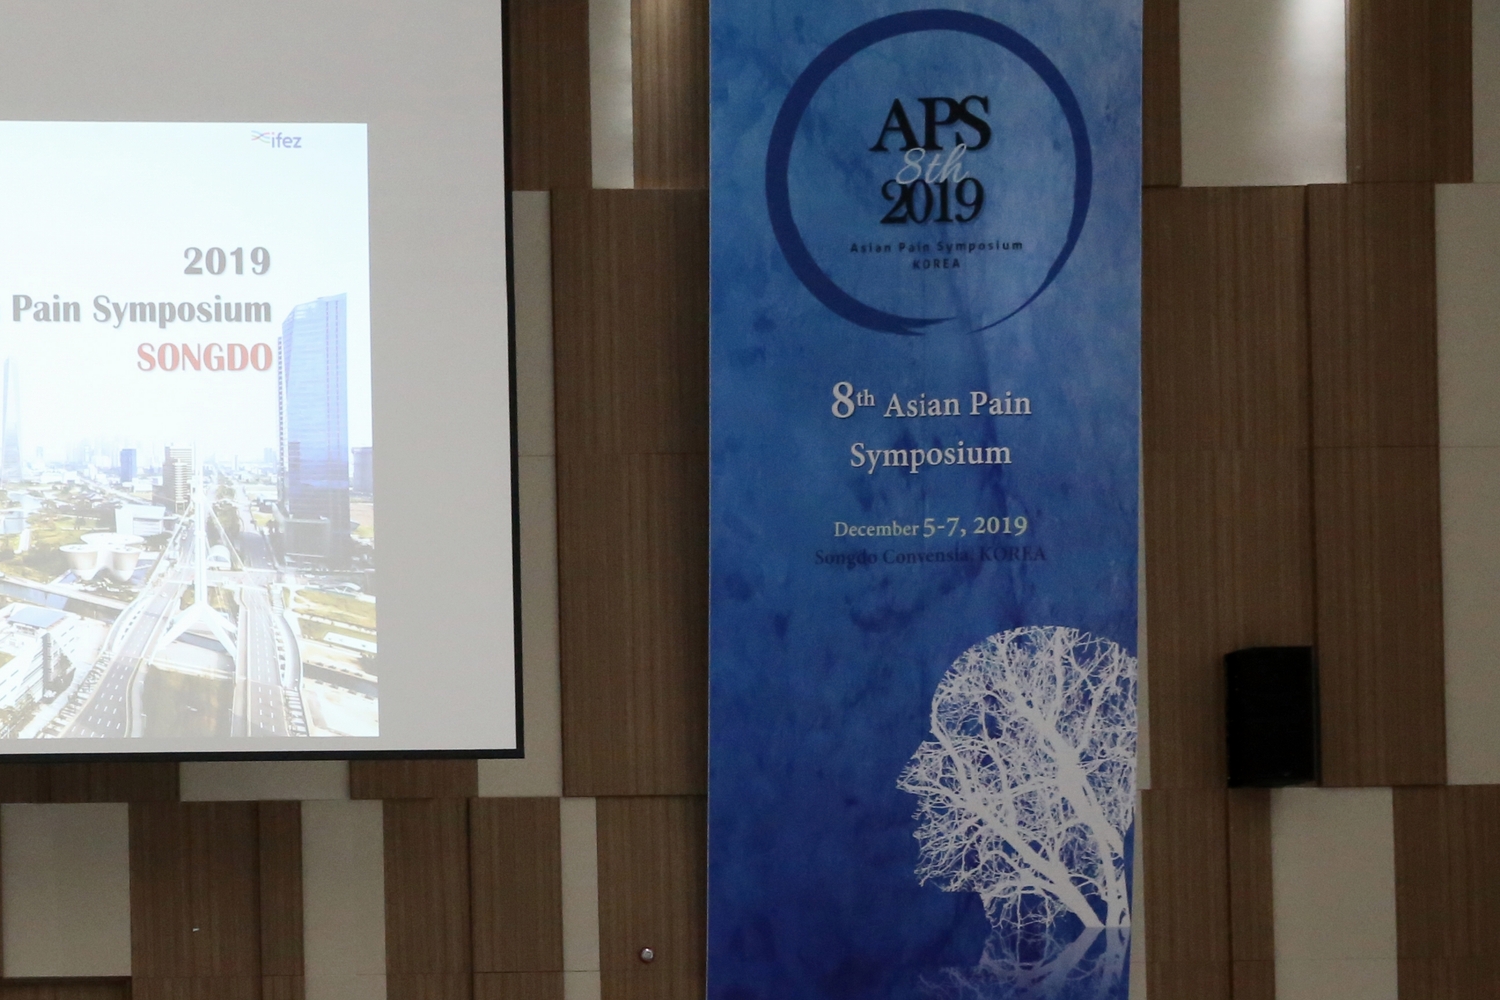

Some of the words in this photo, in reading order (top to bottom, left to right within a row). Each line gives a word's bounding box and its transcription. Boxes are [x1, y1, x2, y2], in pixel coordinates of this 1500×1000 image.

[868, 95, 992, 152] APS
[271, 132, 302, 148] ifez
[895, 144, 971, 185] 8th
[880, 178, 985, 225] 2019
[182, 246, 272, 278] 2019
[850, 242, 892, 254] Asian
[899, 241, 931, 253] Pain
[937, 240, 1024, 254] Symposium
[913, 258, 961, 270] KOREA
[10, 295, 82, 324] Pain
[92, 295, 274, 330] Symposium
[136, 342, 274, 373] SONGDO
[831, 381, 875, 419] 8th
[883, 393, 961, 418] Asian
[970, 391, 1032, 416] Pain
[850, 441, 1012, 474] Symposium
[834, 520, 919, 538] December
[923, 518, 967, 538] 5-7,
[973, 516, 1028, 536] 2019
[815, 548, 878, 570] Songdo
[883, 546, 973, 565] Convensia,
[980, 545, 1047, 562] KOREA
